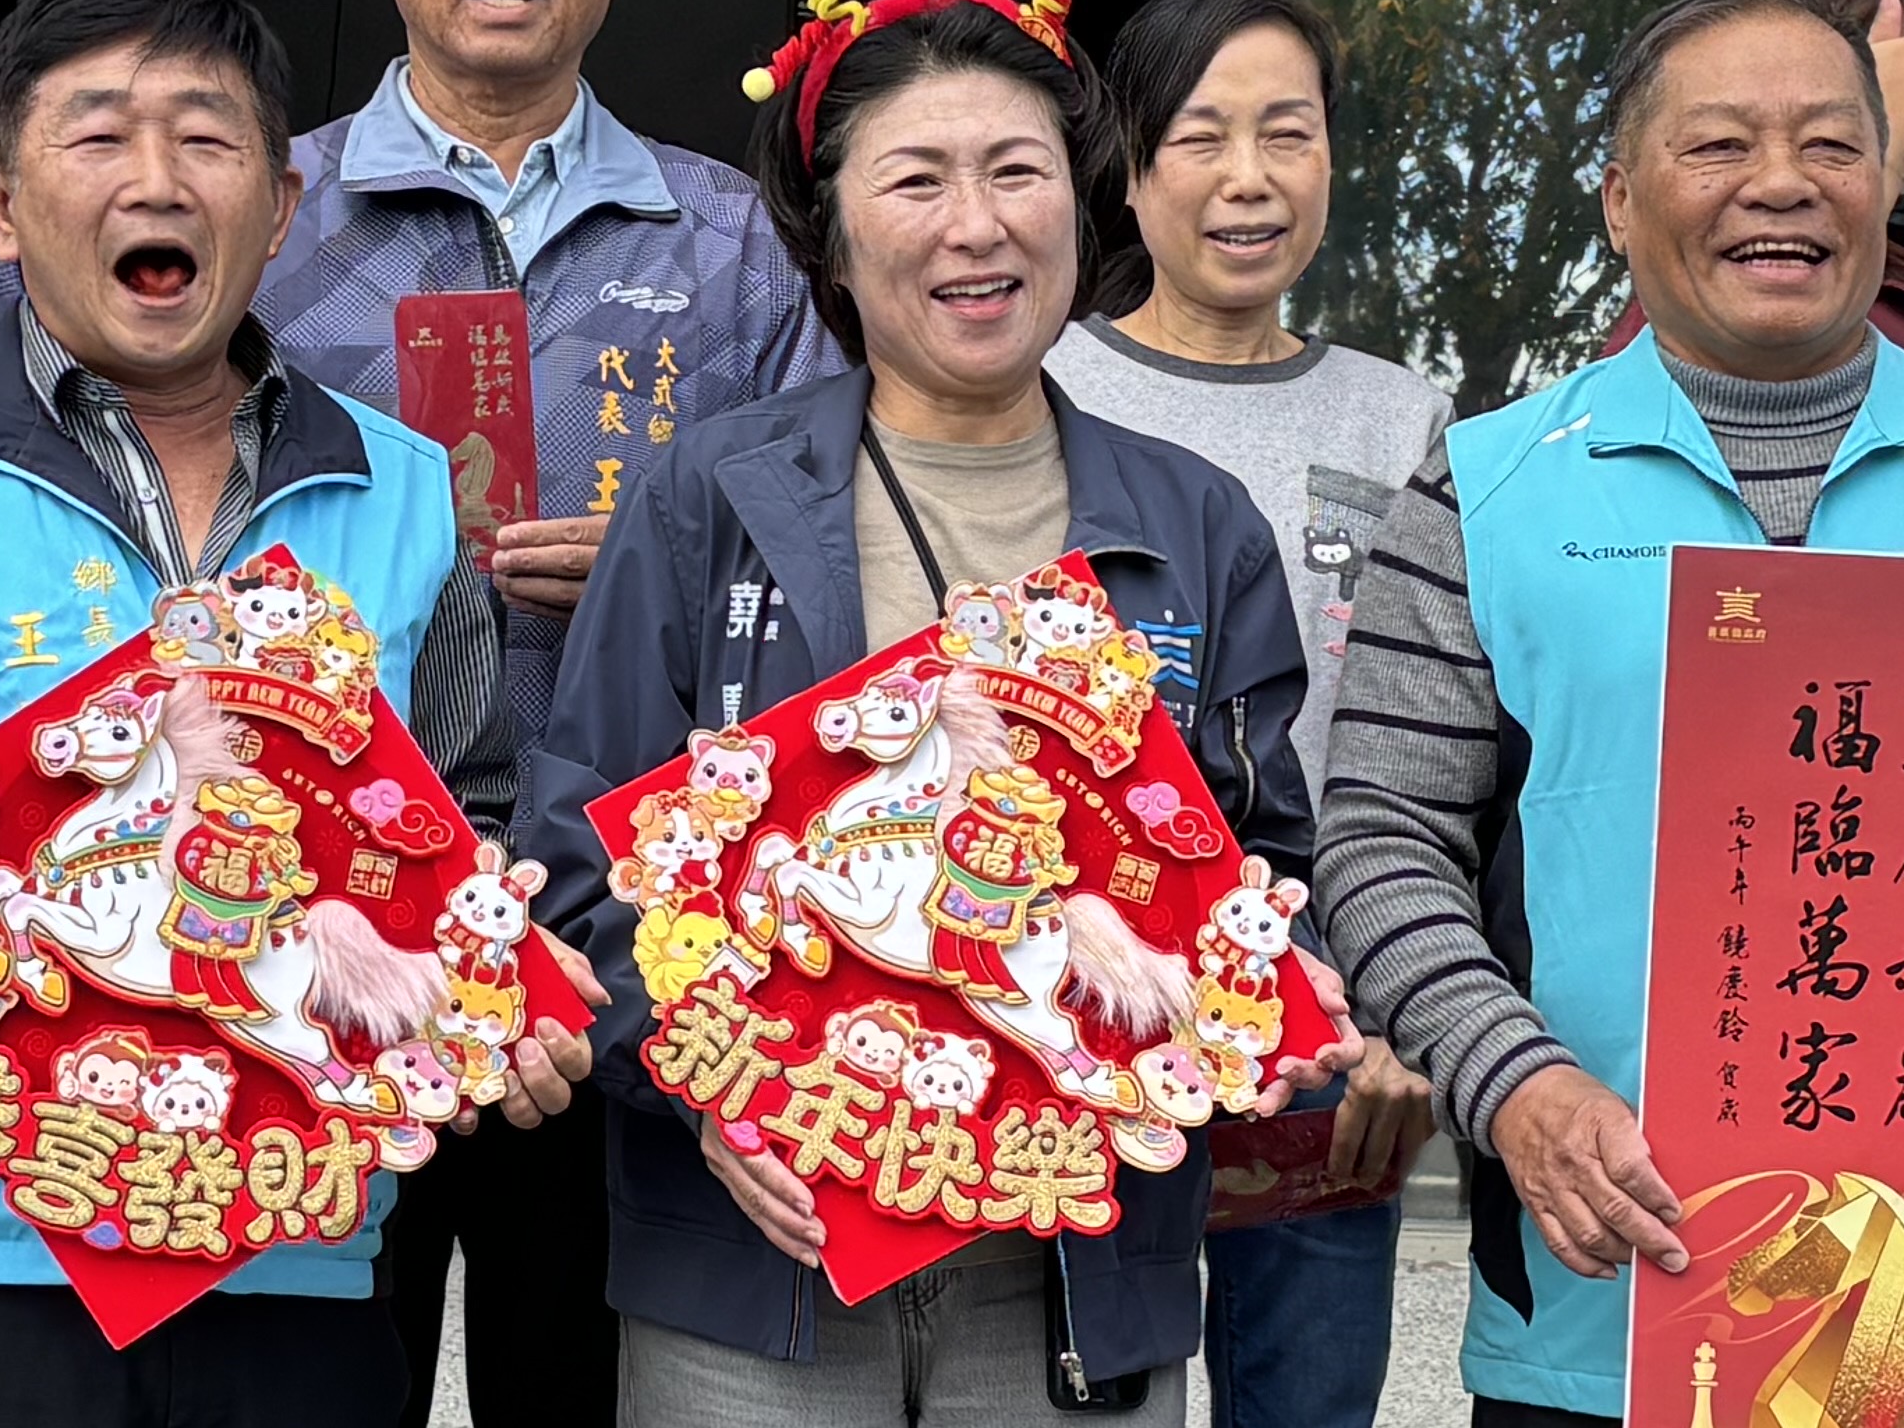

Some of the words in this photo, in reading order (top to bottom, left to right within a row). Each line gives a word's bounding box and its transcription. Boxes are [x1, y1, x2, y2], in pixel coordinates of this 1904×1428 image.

[596, 345, 637, 436] 代表
[587, 458, 624, 513] 王
[248, 683, 284, 708] NEW
[287, 693, 329, 726] YEAR
[1021, 687, 1058, 713] NEW
[1058, 701, 1098, 738] YEAR
[198, 838, 254, 897] 福
[963, 824, 1019, 880] 福
[1776, 679, 1882, 1132] 福臨萬家
[649, 977, 1112, 1230] 新年快樂
